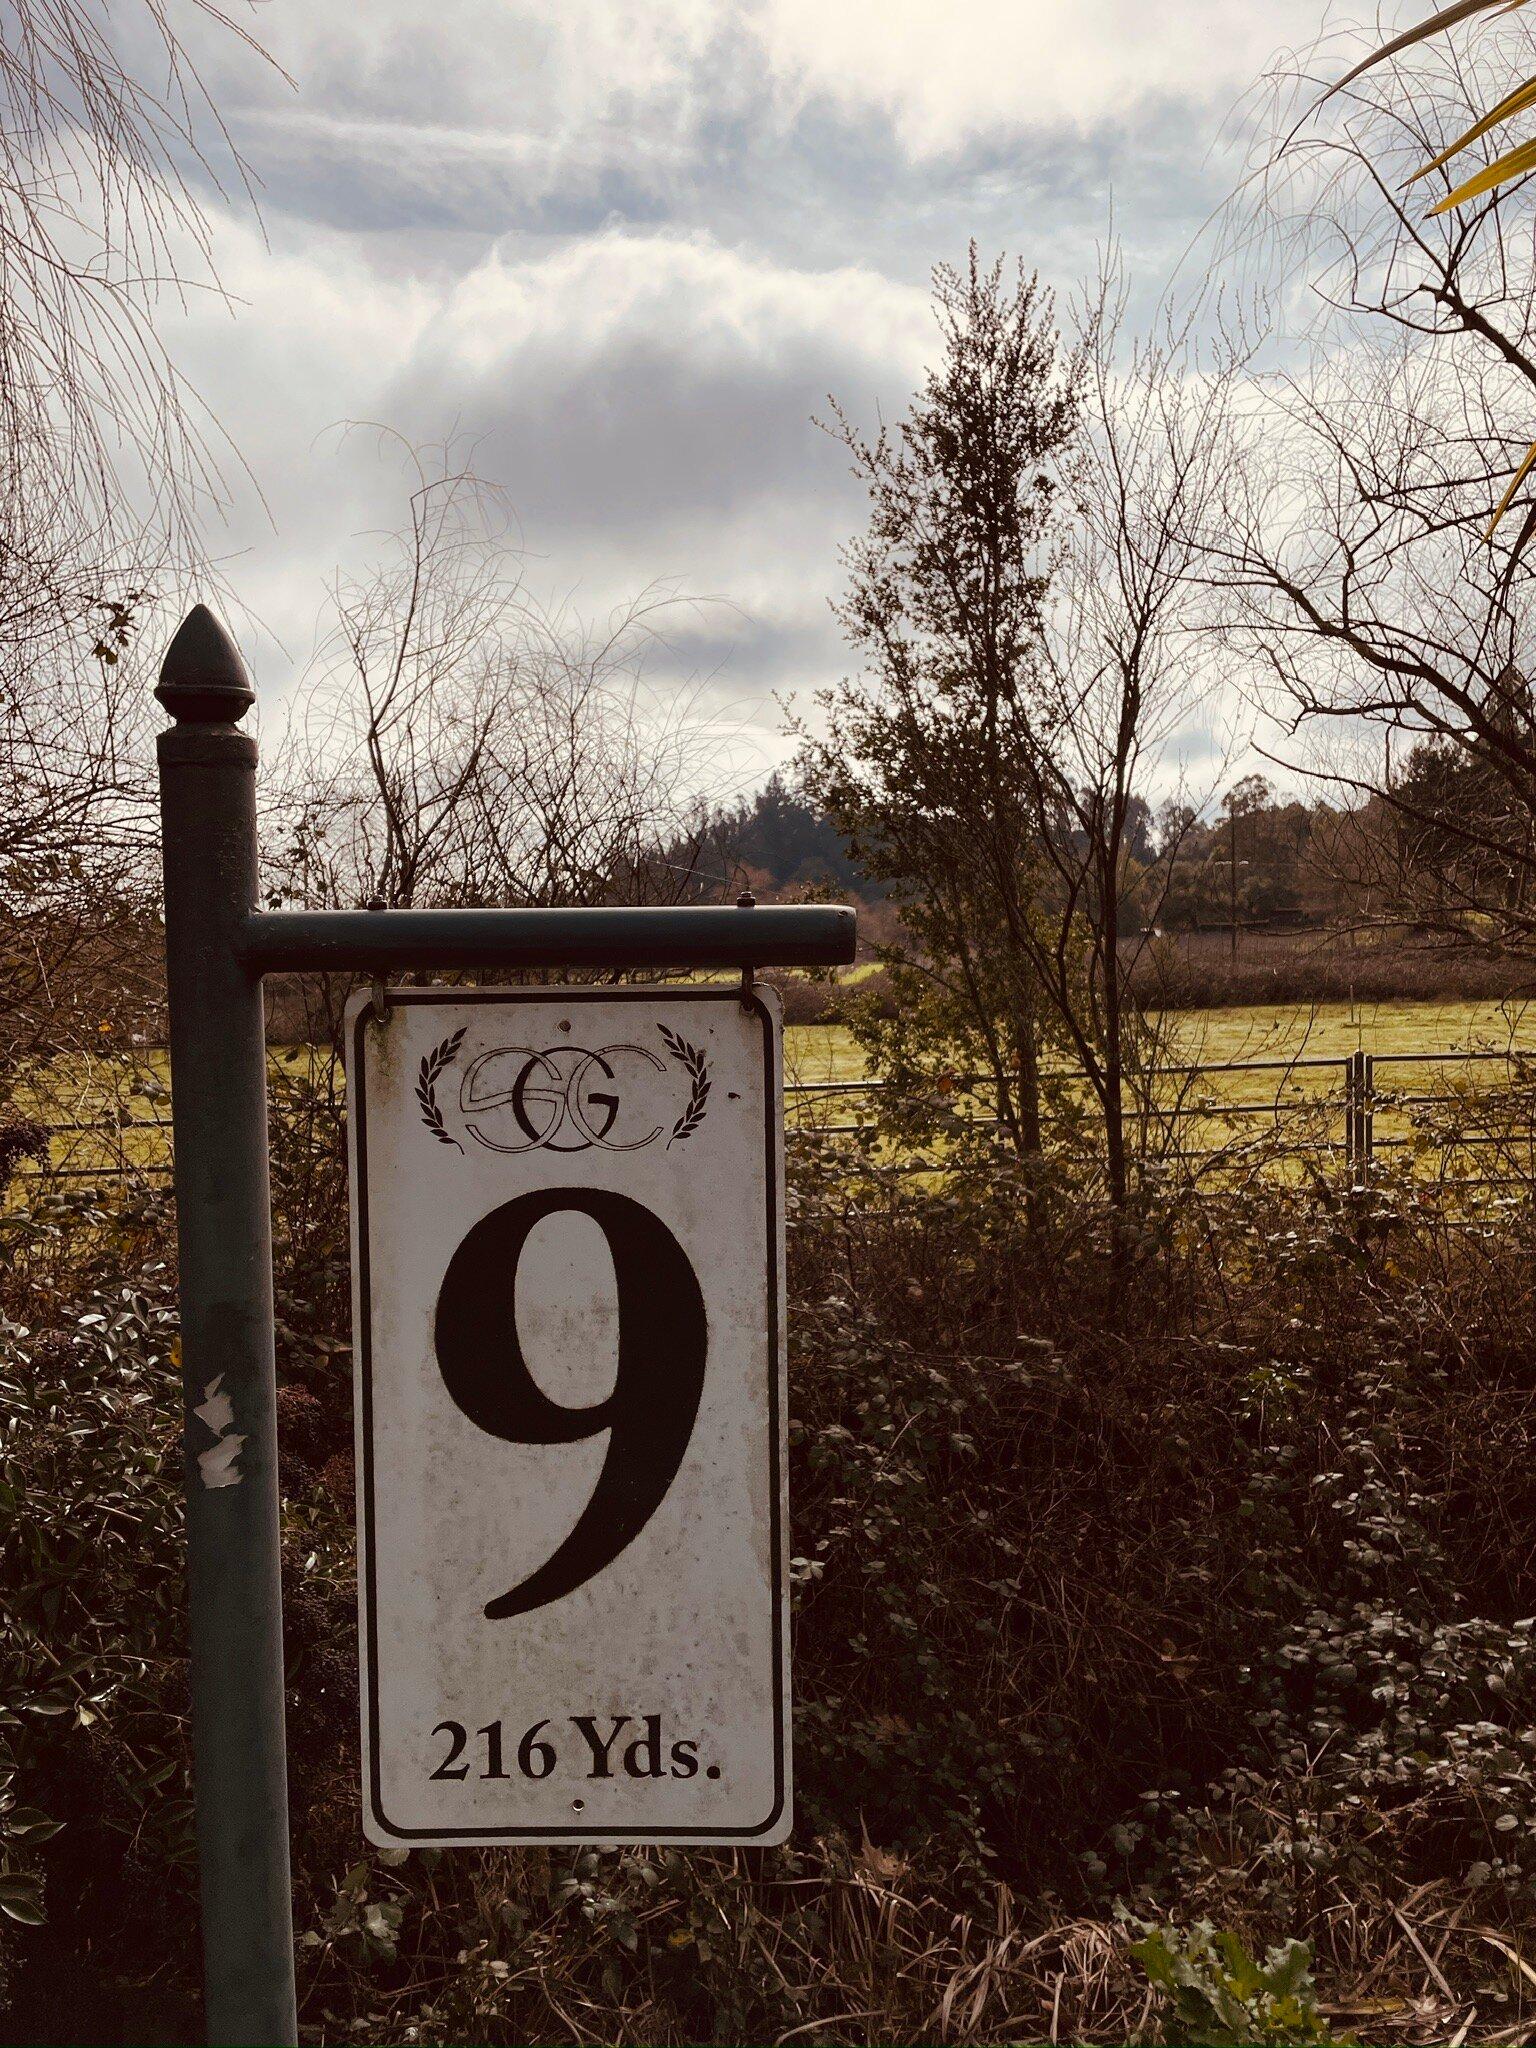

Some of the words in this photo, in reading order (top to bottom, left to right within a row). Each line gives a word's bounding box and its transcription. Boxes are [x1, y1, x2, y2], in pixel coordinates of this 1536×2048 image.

[433, 1186, 709, 1621] 9
[428, 1718, 558, 1782] 216
[567, 1713, 721, 1781] Yds.
